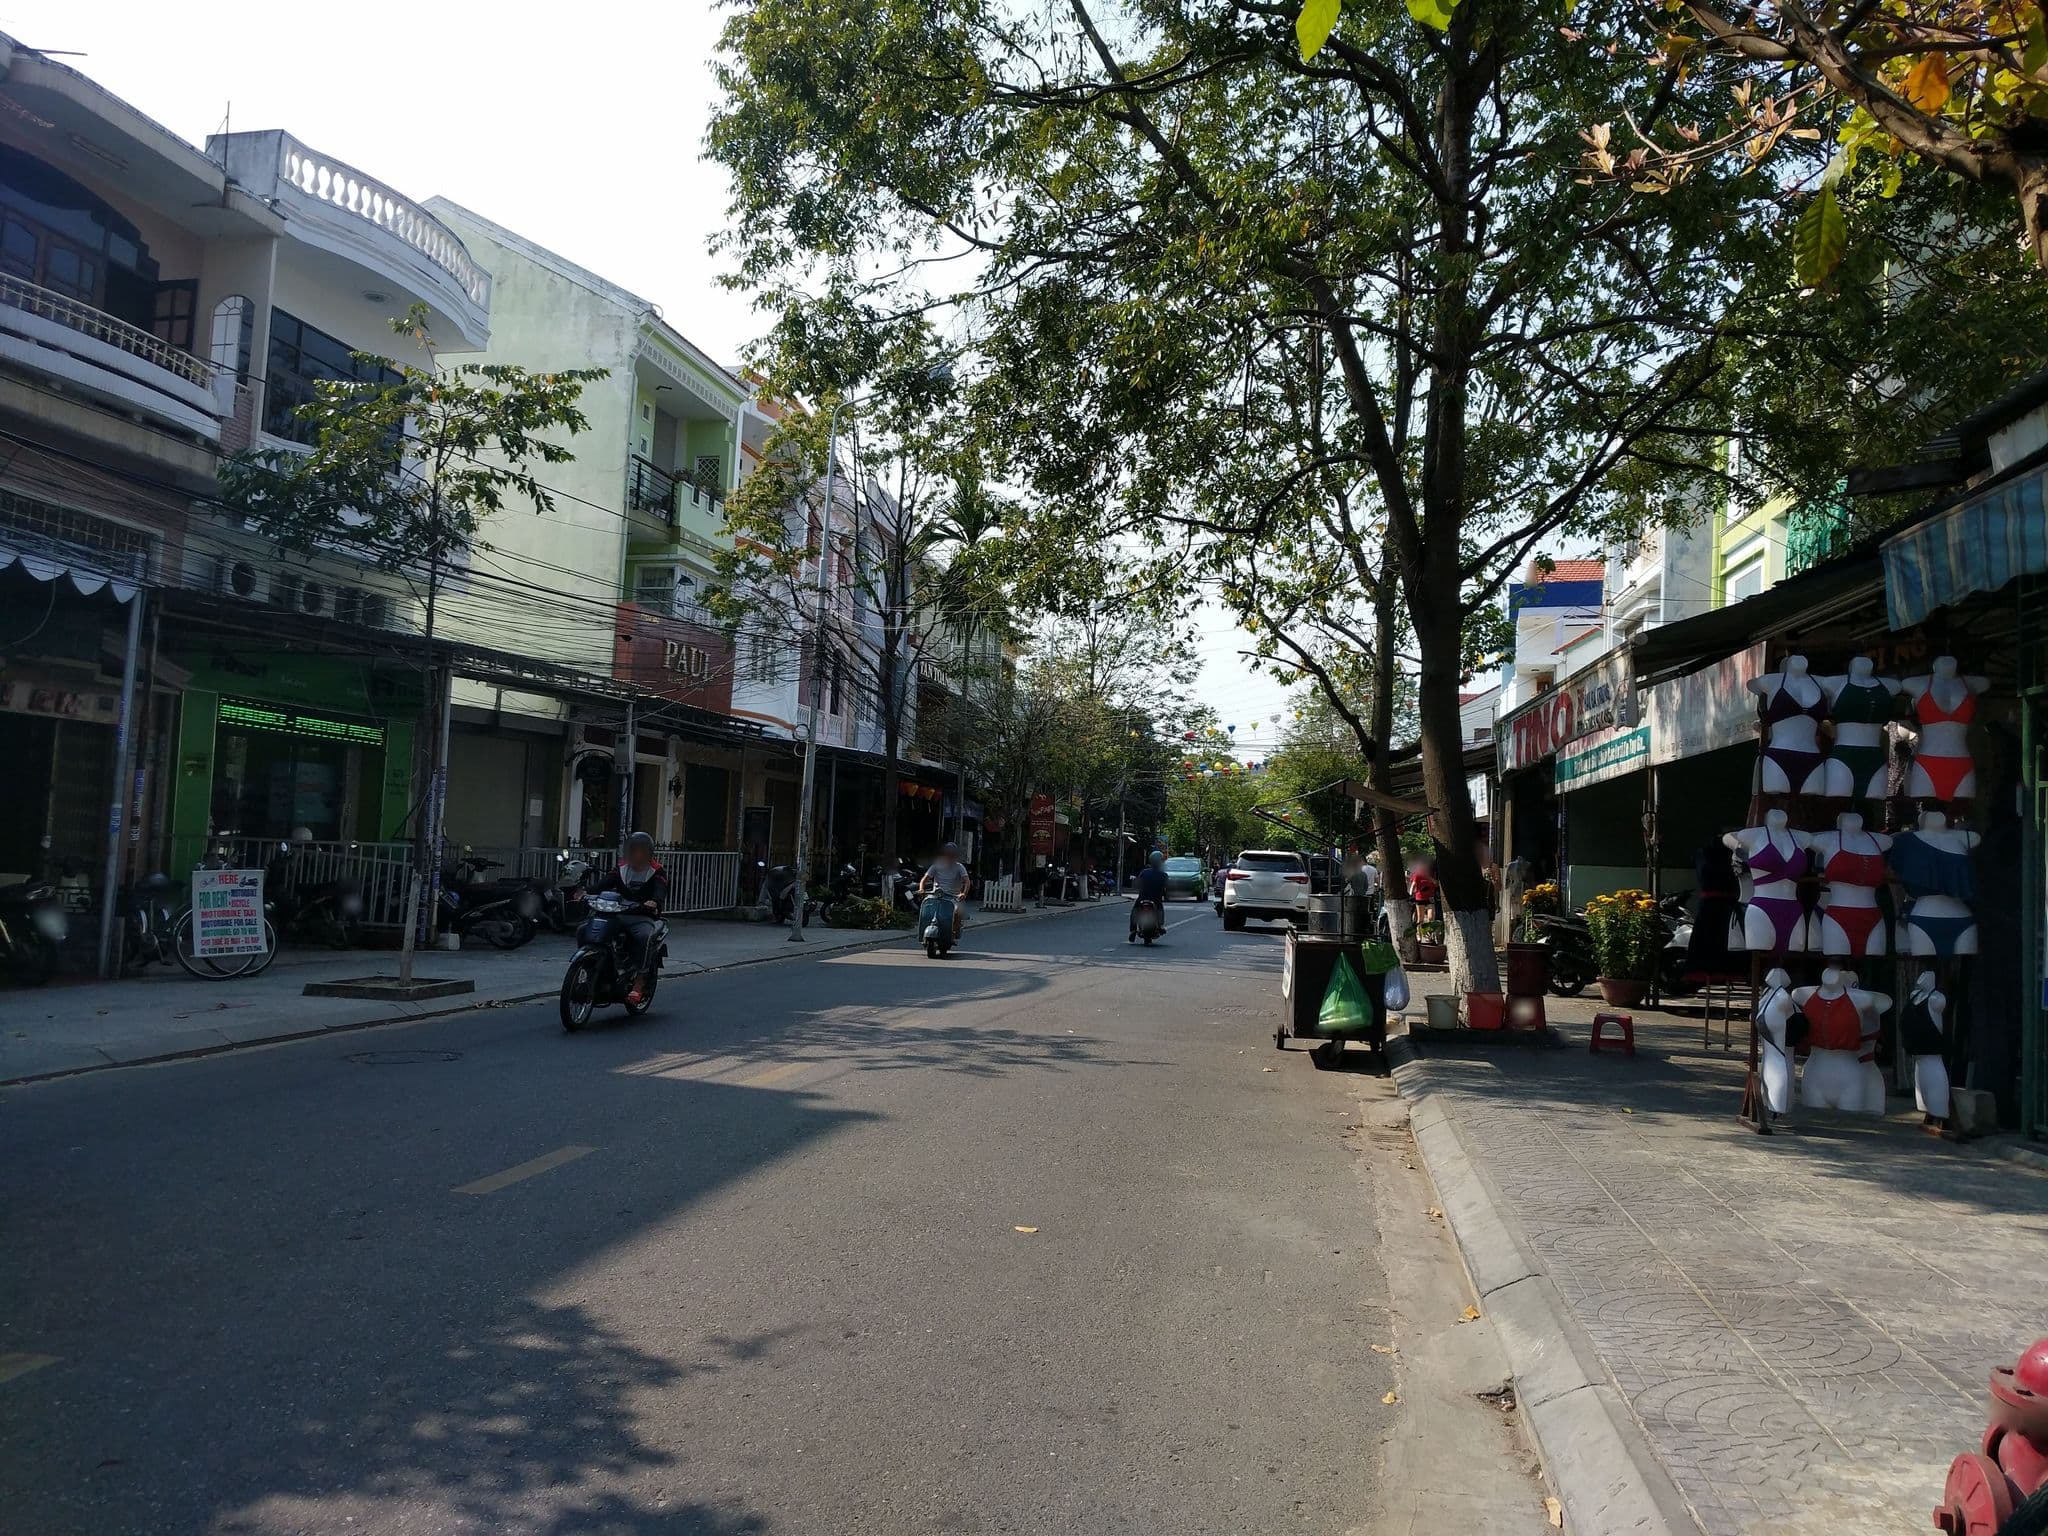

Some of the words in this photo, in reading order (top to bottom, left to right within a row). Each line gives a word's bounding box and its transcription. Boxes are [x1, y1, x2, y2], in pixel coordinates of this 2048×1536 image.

[218, 874, 239, 885] HERE
[199, 891, 211, 909] FOR
[201, 910, 241, 918] MOTORBIKE
[243, 909, 257, 917] TAXI
[201, 919, 232, 928] MOTORBIKE
[234, 918, 243, 926] FOR
[245, 918, 258, 926] SALE
